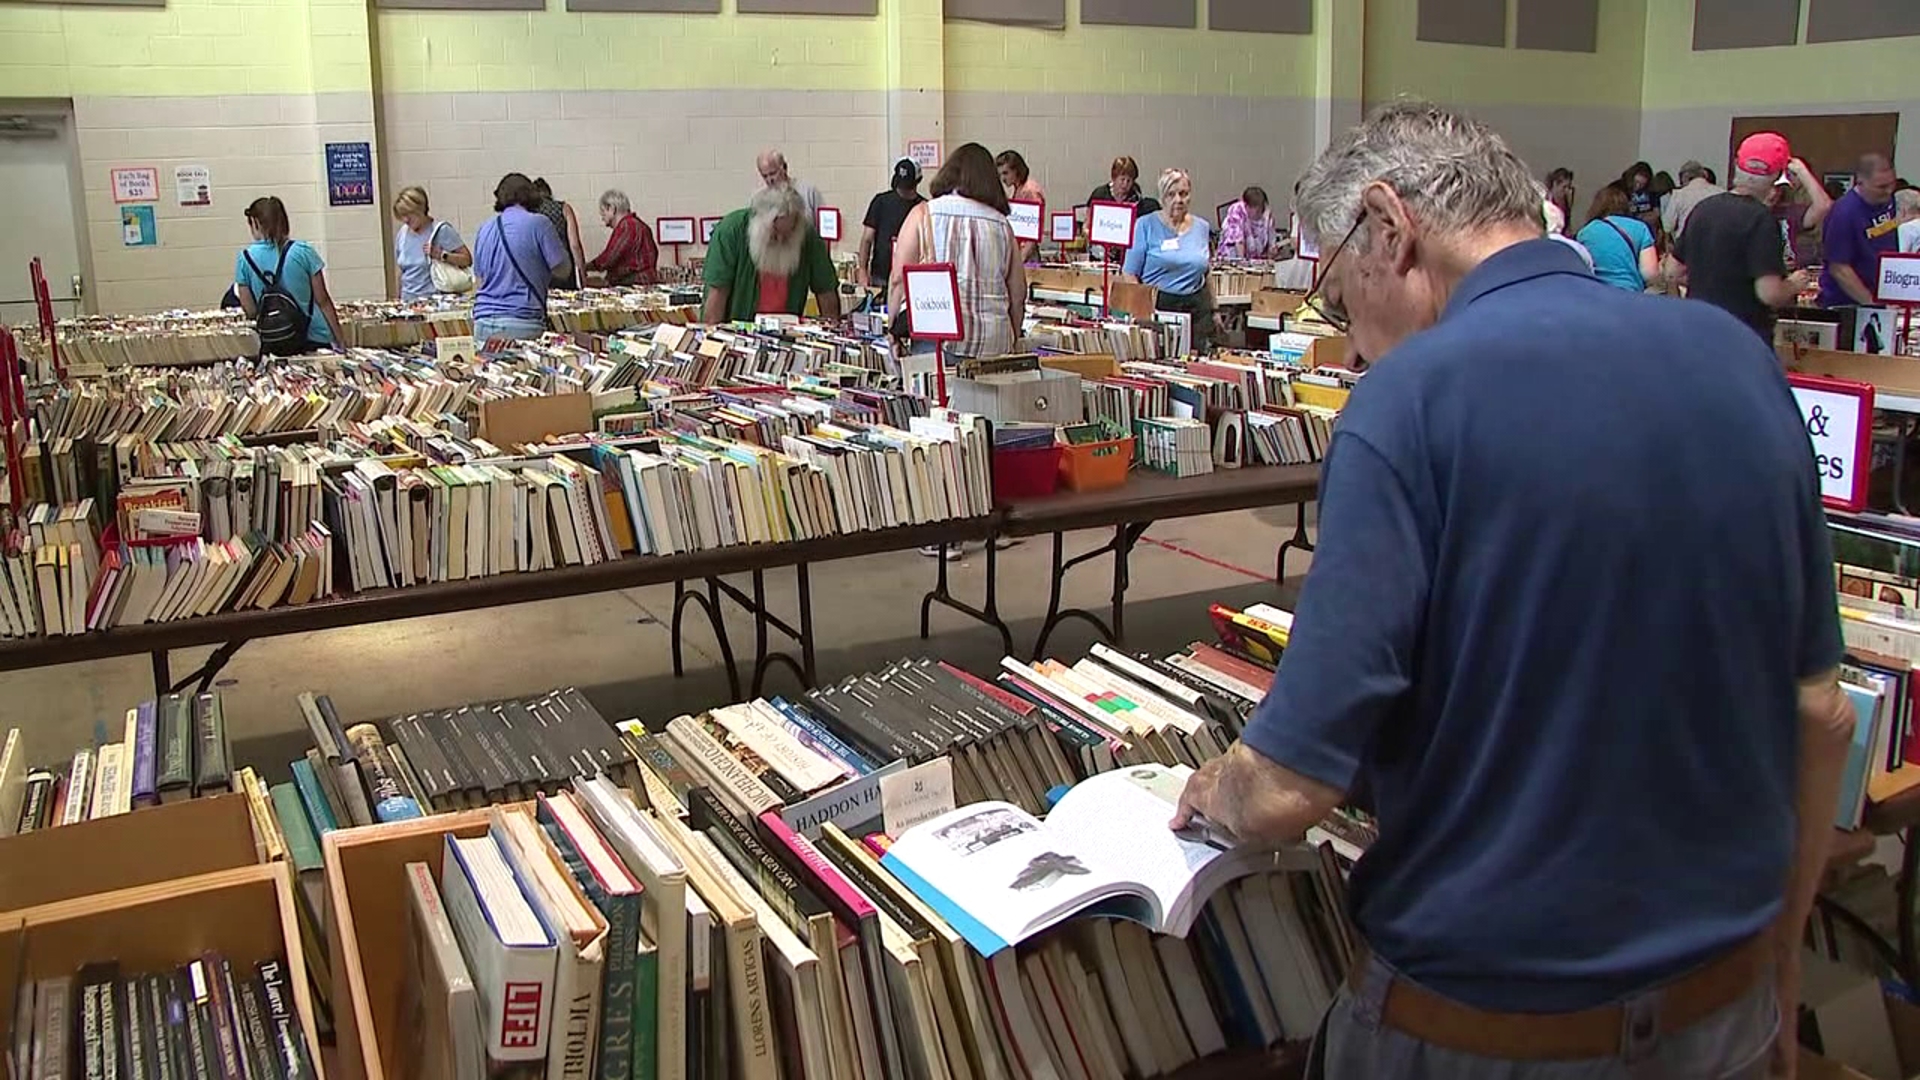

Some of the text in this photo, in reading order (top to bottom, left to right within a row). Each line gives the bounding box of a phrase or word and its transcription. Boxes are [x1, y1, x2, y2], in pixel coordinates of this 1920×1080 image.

[1884, 270, 1920, 289] Biogra
[915, 296, 951, 311] Cookbooks
[1807, 404, 1829, 437] &
[125, 500, 181, 513] Breakfast
[704, 748, 771, 808] MICHELANGELO
[795, 793, 861, 832] HADDON
[611, 902, 625, 971] PHAIDON
[261, 961, 280, 981] The
[266, 980, 286, 1010] Louvre
[742, 938, 766, 1057] LLORENS ARTIGAS
[504, 985, 541, 1046] LIFE
[563, 992, 591, 1080] VICTORI
